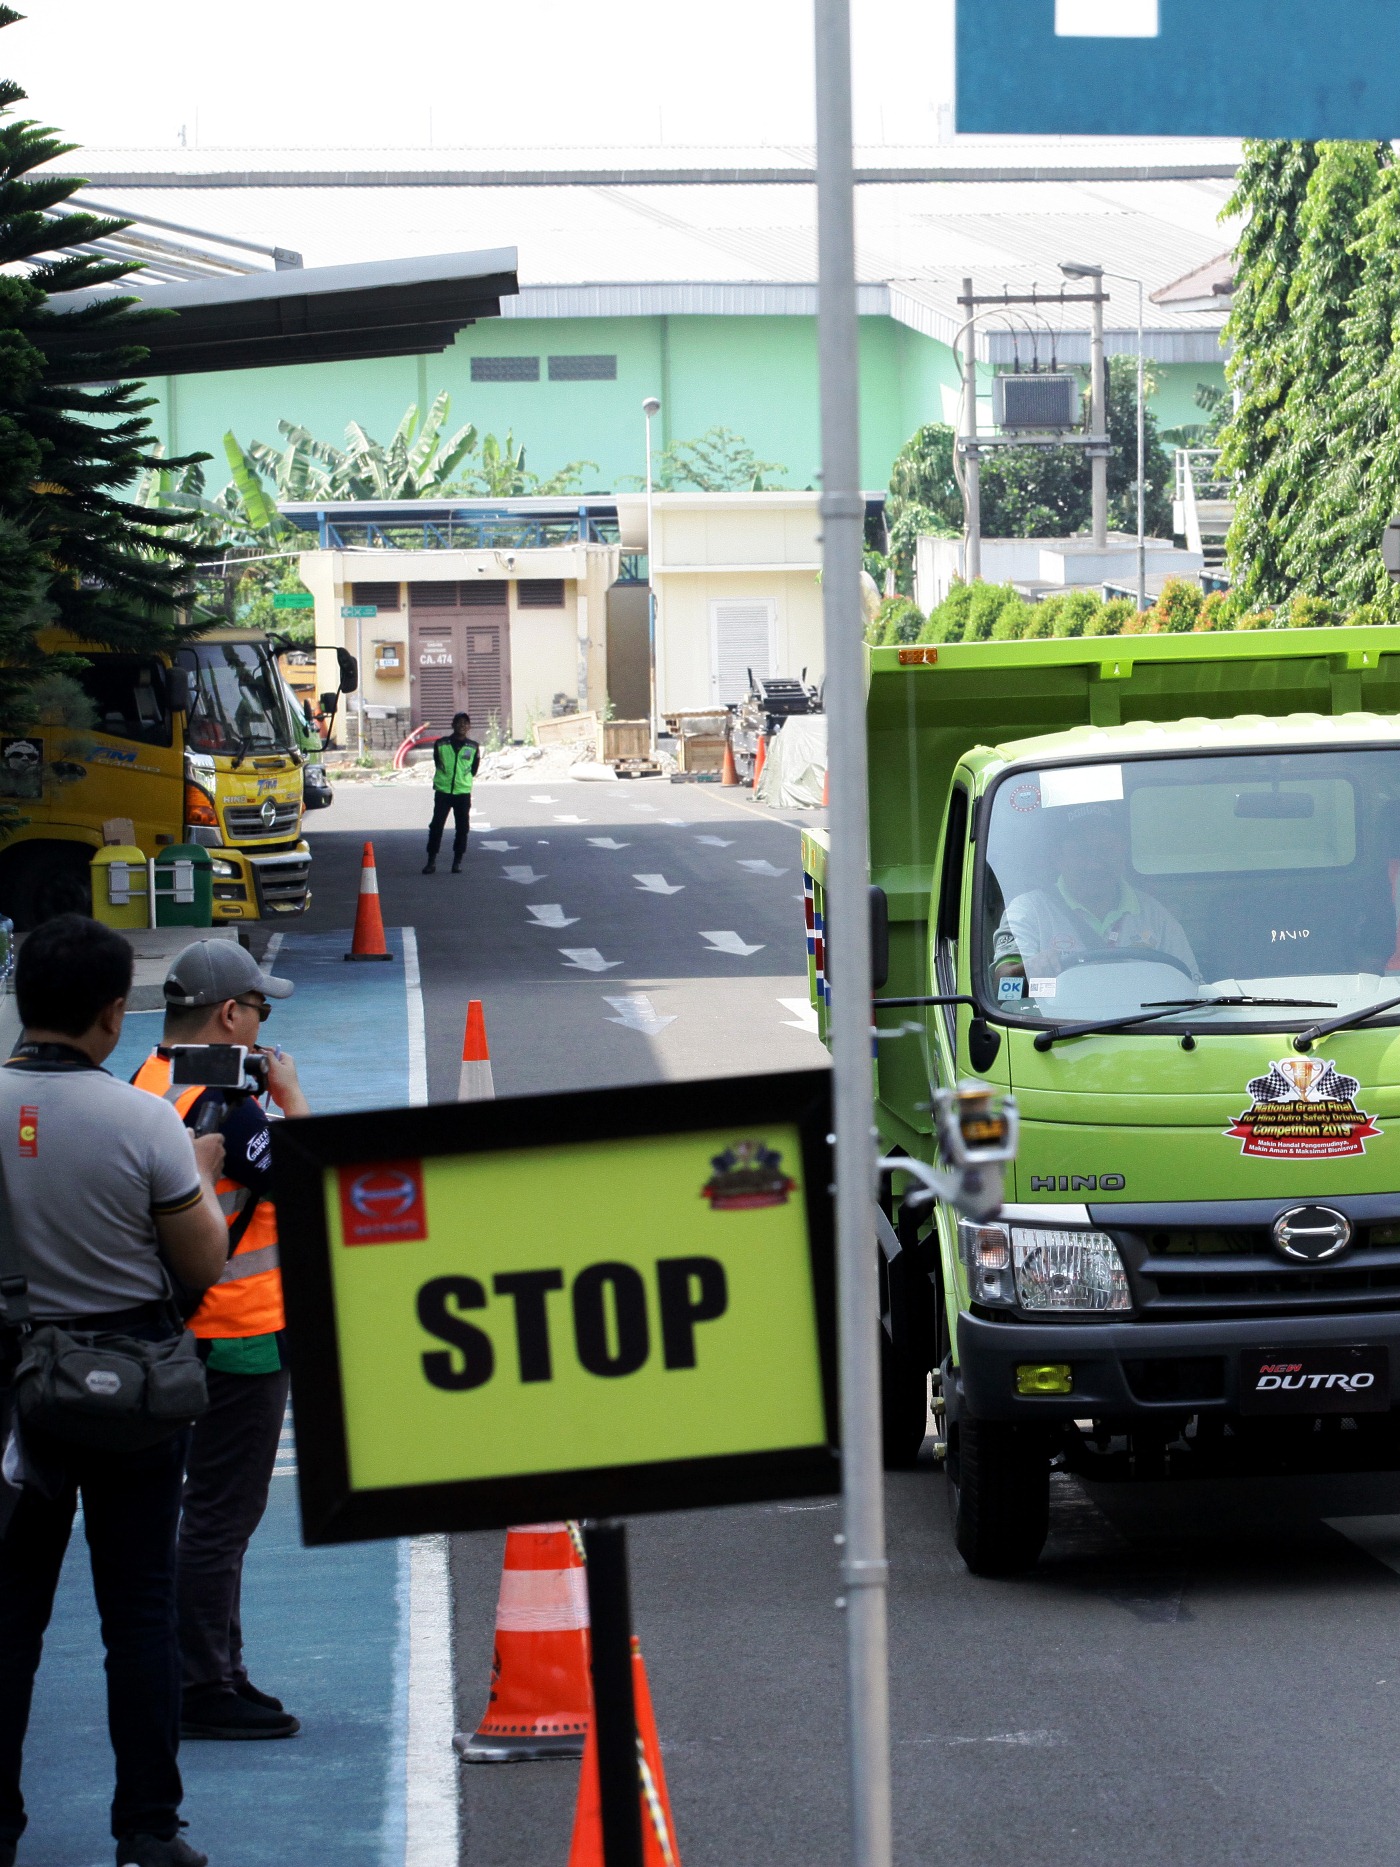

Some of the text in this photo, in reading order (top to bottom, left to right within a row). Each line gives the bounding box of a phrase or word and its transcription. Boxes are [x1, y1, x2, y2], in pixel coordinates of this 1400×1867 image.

[1001, 982, 1021, 993] OK
[1254, 1101, 1353, 1113] National Grand Final
[1242, 1113, 1366, 1123] for Hino Dutro Safety Driving
[1252, 1124, 1351, 1139] Competition 2019
[1257, 1139, 1277, 1147] Makin
[1248, 1144, 1268, 1153] Makin
[1327, 1144, 1358, 1154] Bisnisnya
[1031, 1173, 1125, 1192] HINO
[415, 1255, 729, 1392] STOP
[1259, 1363, 1302, 1373] NEW
[1256, 1372, 1375, 1392] DUTRO
